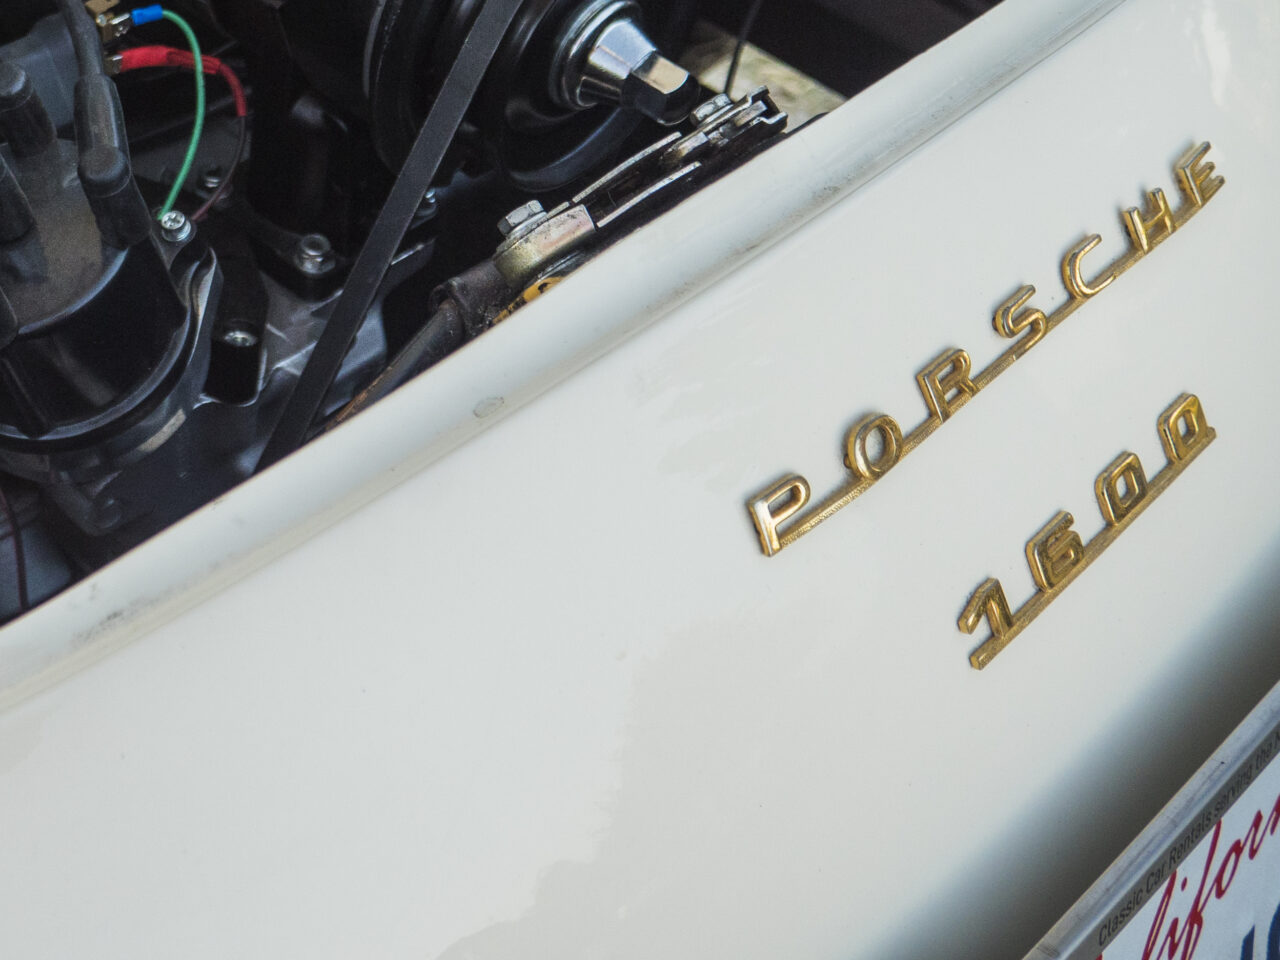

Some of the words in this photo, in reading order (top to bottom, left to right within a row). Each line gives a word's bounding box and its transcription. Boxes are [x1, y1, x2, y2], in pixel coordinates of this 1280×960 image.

[748, 141, 1225, 557] PORSCHE
[957, 393, 1217, 668] 1600
[1099, 889, 1142, 946] Classic
[1146, 863, 1166, 893] Car
[1169, 813, 1212, 864] Rentals
[1214, 767, 1253, 811] serving
